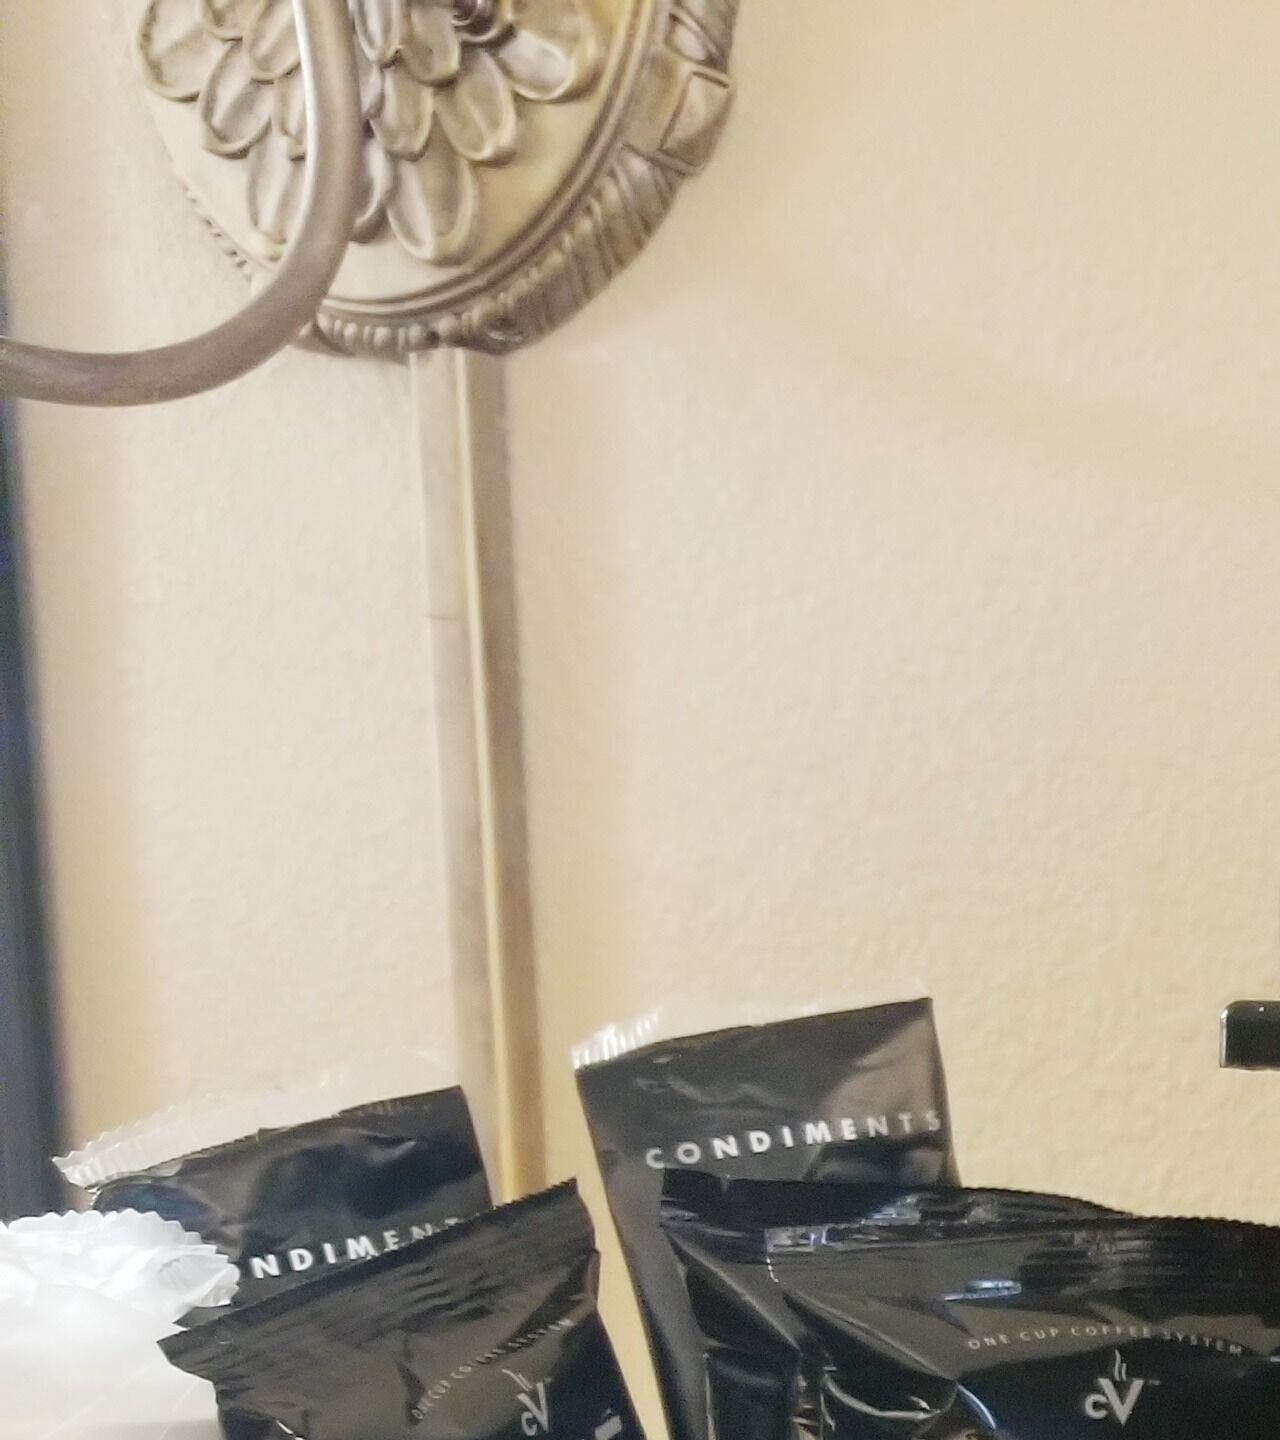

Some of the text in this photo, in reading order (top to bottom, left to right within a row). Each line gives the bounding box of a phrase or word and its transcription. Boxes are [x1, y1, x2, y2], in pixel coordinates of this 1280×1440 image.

[645, 1111, 941, 1169] CONDIMENTS
[968, 1326, 1242, 1357] ONE CUP COFFEE SYSTEM
